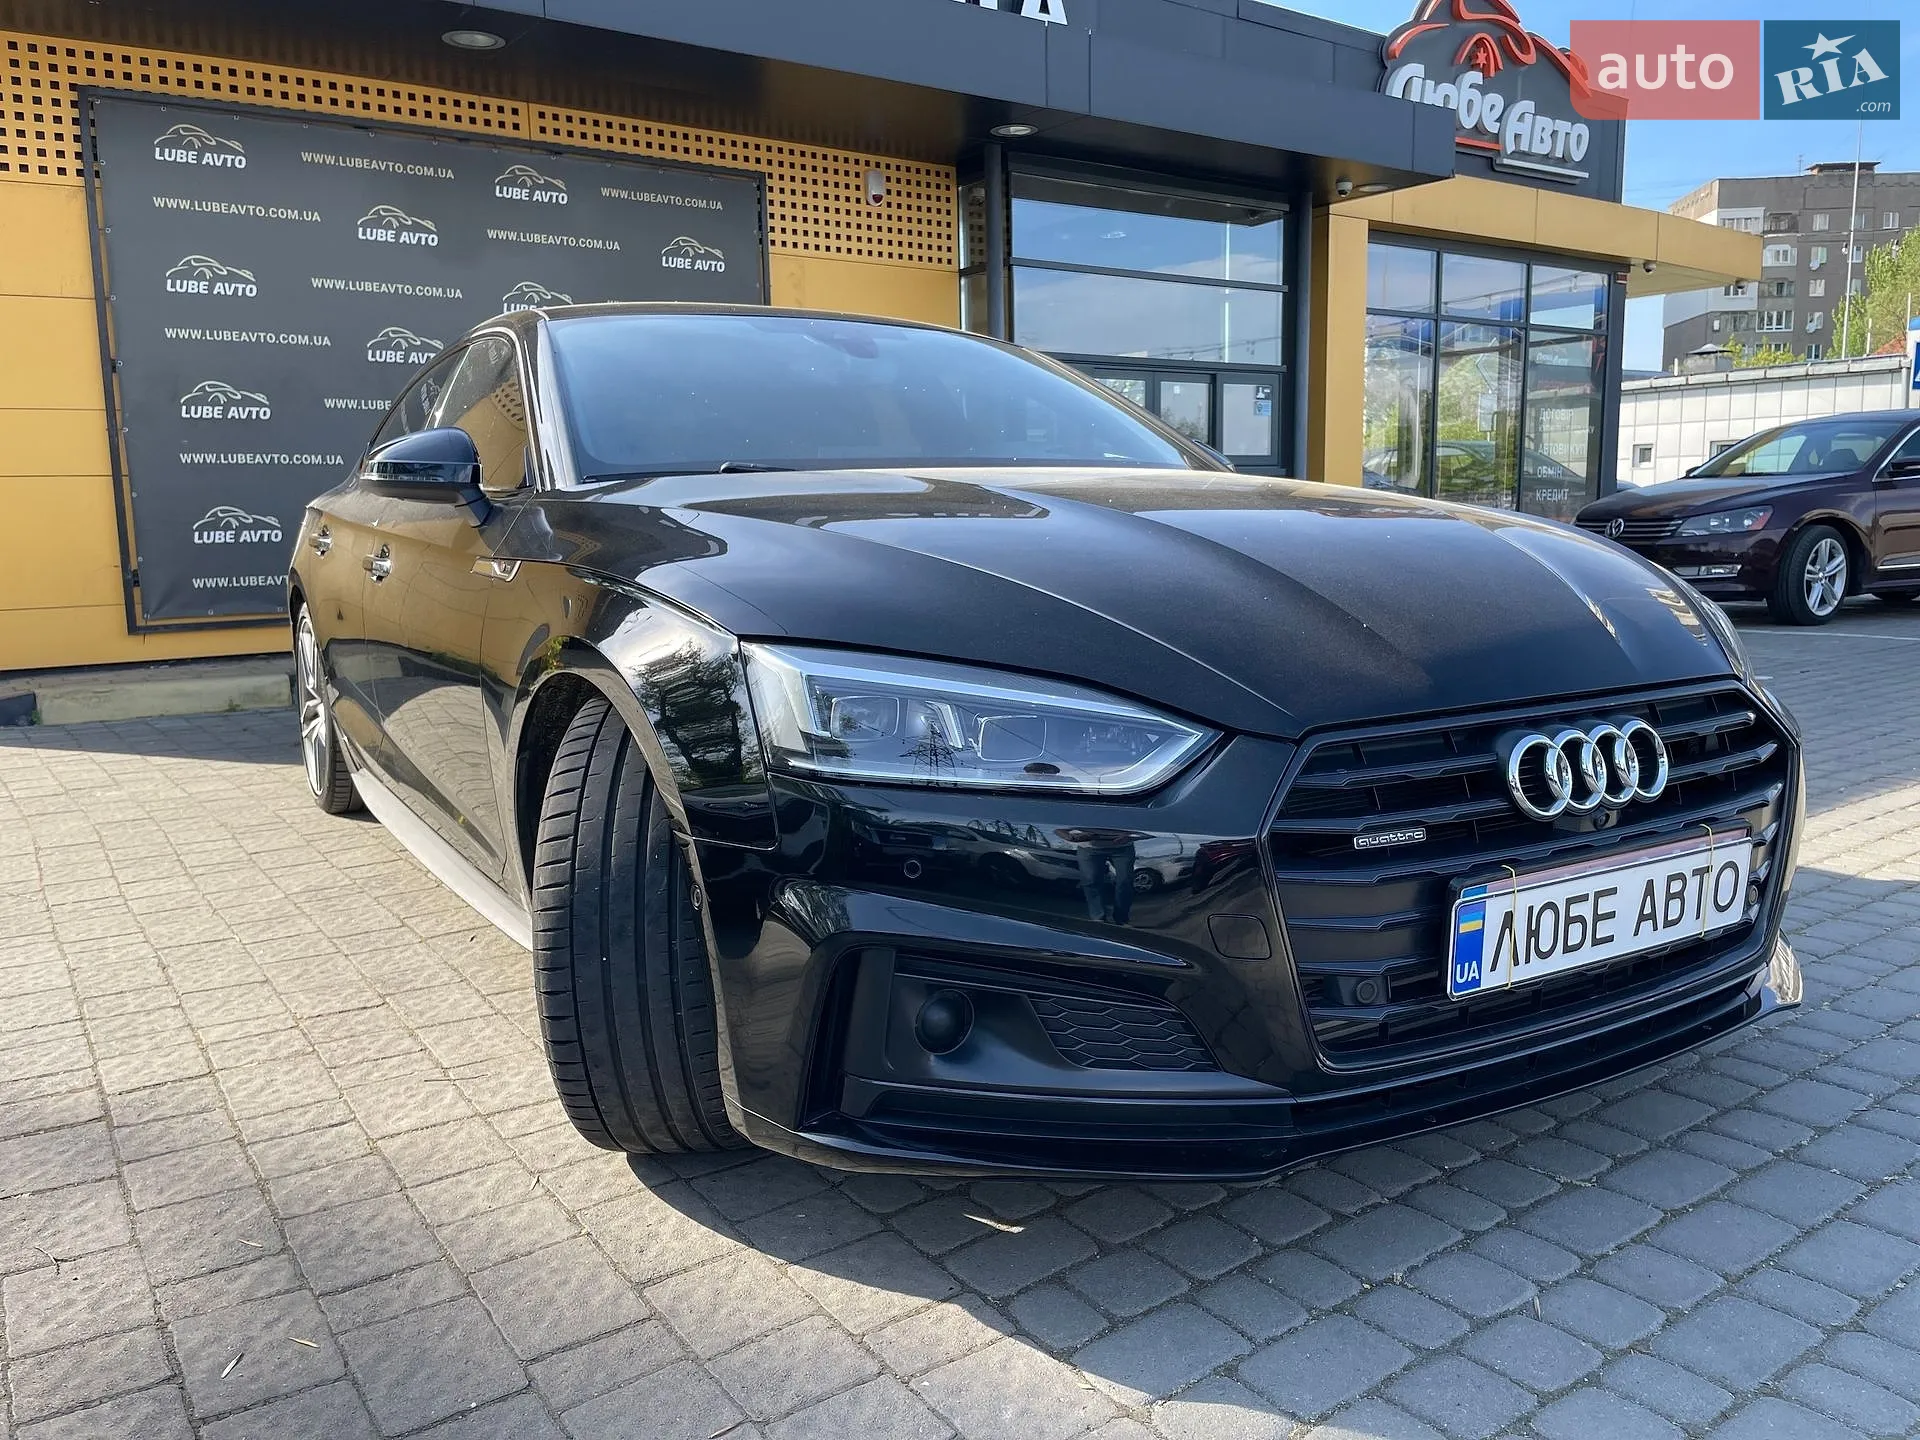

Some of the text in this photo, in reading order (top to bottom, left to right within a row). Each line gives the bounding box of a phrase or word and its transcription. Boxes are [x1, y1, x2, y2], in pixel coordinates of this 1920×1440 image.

[154, 147, 247, 169] LUBE AVTO
[301, 151, 455, 180] WWW.LUBEAVTO.COM.UA
[495, 184, 568, 205] LUBE AVTO
[600, 187, 723, 211] WWW.LUBEAVTO.COM.UA
[153, 196, 321, 222] WWW.LUBEAVTO.COM.UA
[357, 226, 439, 246] LUBE AVTO
[487, 228, 621, 251] WWW.LUBEAVTO.COM.UA
[661, 255, 726, 273] LUBE AVTO
[166, 278, 258, 297] LUBE AVTO
[311, 277, 463, 299] WWW.LUBEAVTO.COM.UA
[164, 327, 331, 347] WWW.LUBEAVTO.COM.UA
[367, 349, 405, 364] LUBE
[181, 405, 272, 420] LUBE AVTO
[179, 452, 344, 466] WWW.LUBEAVTO.COM.UA
[1536, 488, 1569, 502] КРЕДИТ
[193, 529, 283, 545] LUBE AVTO
[1358, 831, 1424, 847] quattro
[1489, 861, 1740, 973] ЛЮБЕ АВТО
[1456, 960, 1480, 984] UA
